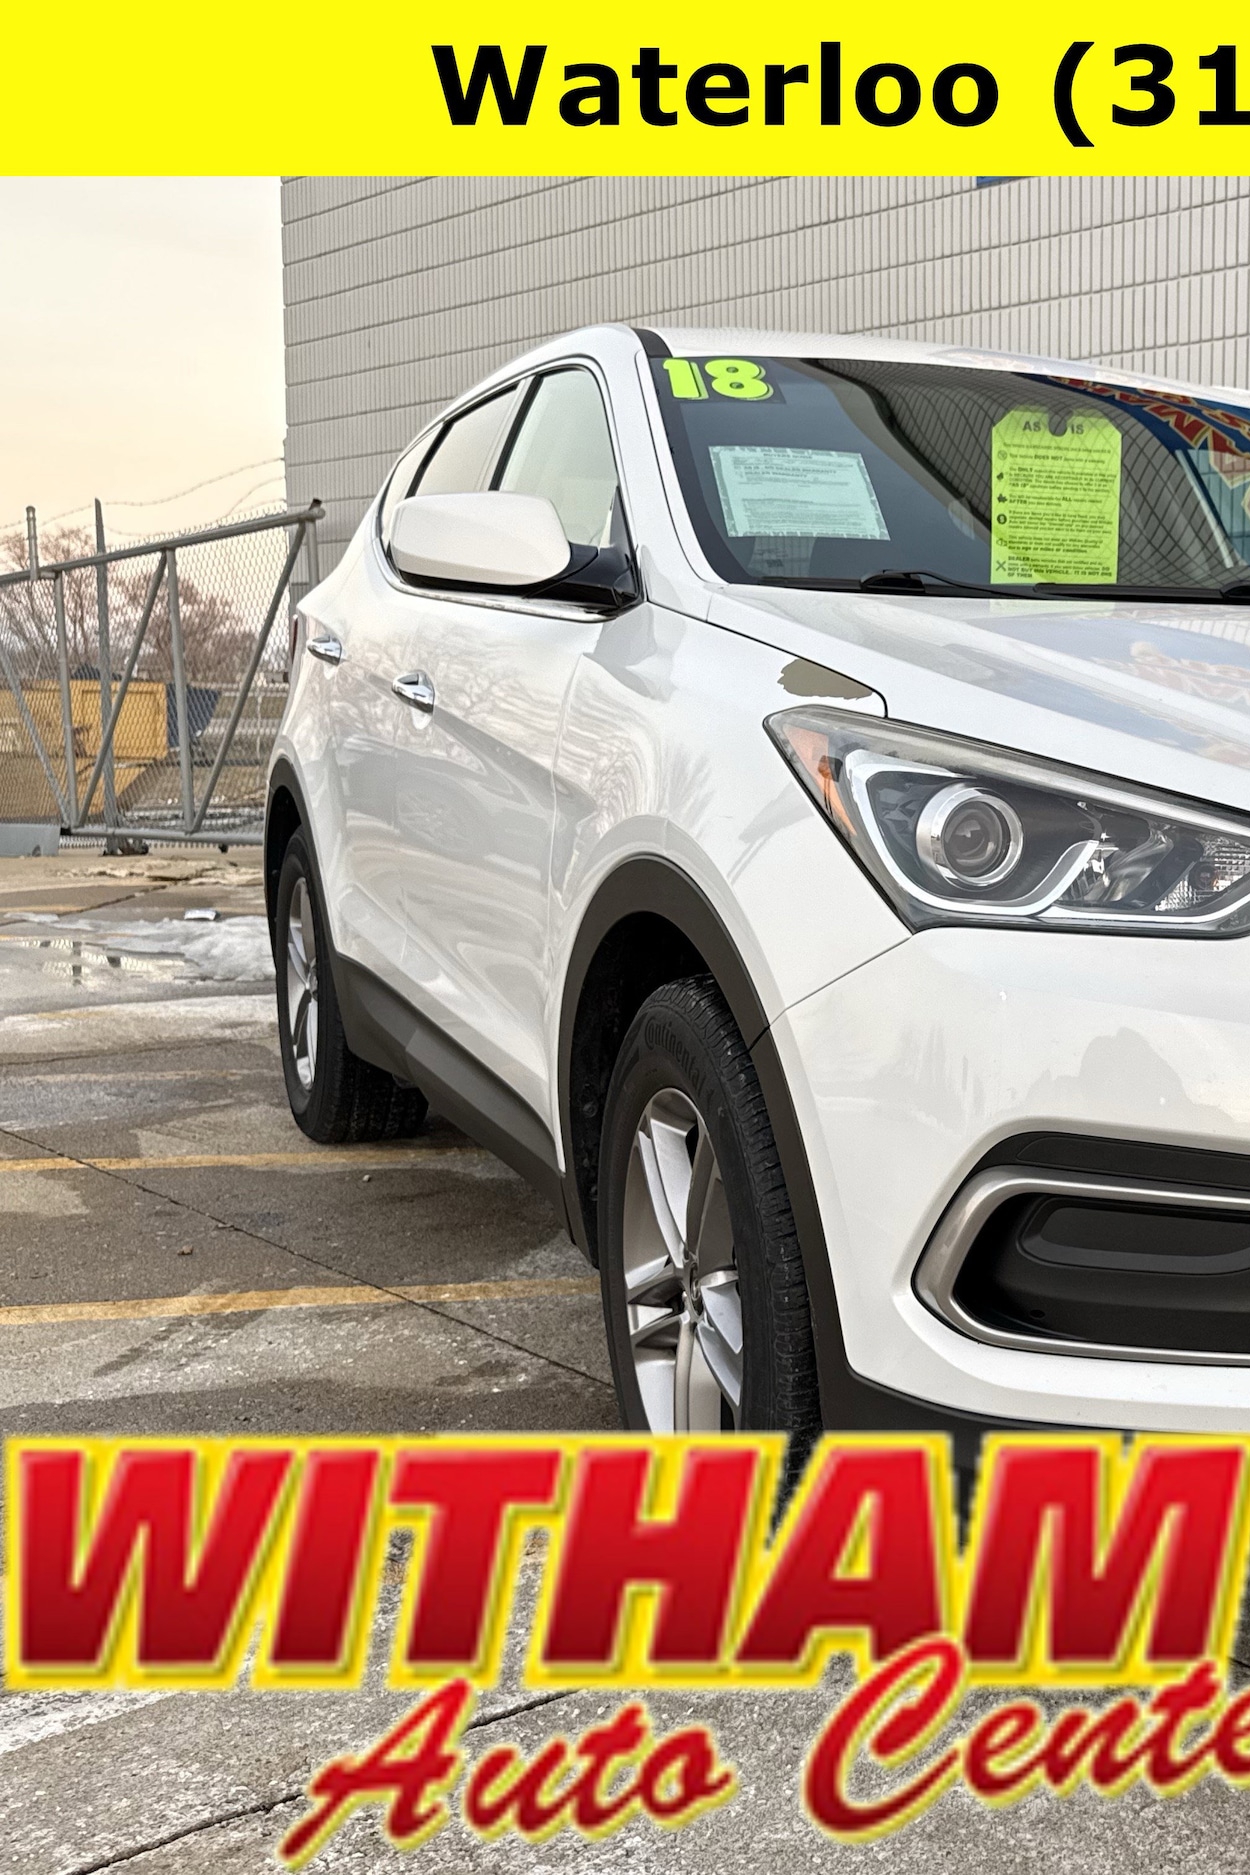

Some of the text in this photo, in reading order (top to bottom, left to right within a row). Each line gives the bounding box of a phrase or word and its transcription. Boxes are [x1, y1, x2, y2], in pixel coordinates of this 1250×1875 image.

[663, 358, 774, 400] 18
[1022, 420, 1084, 435] AS IS
